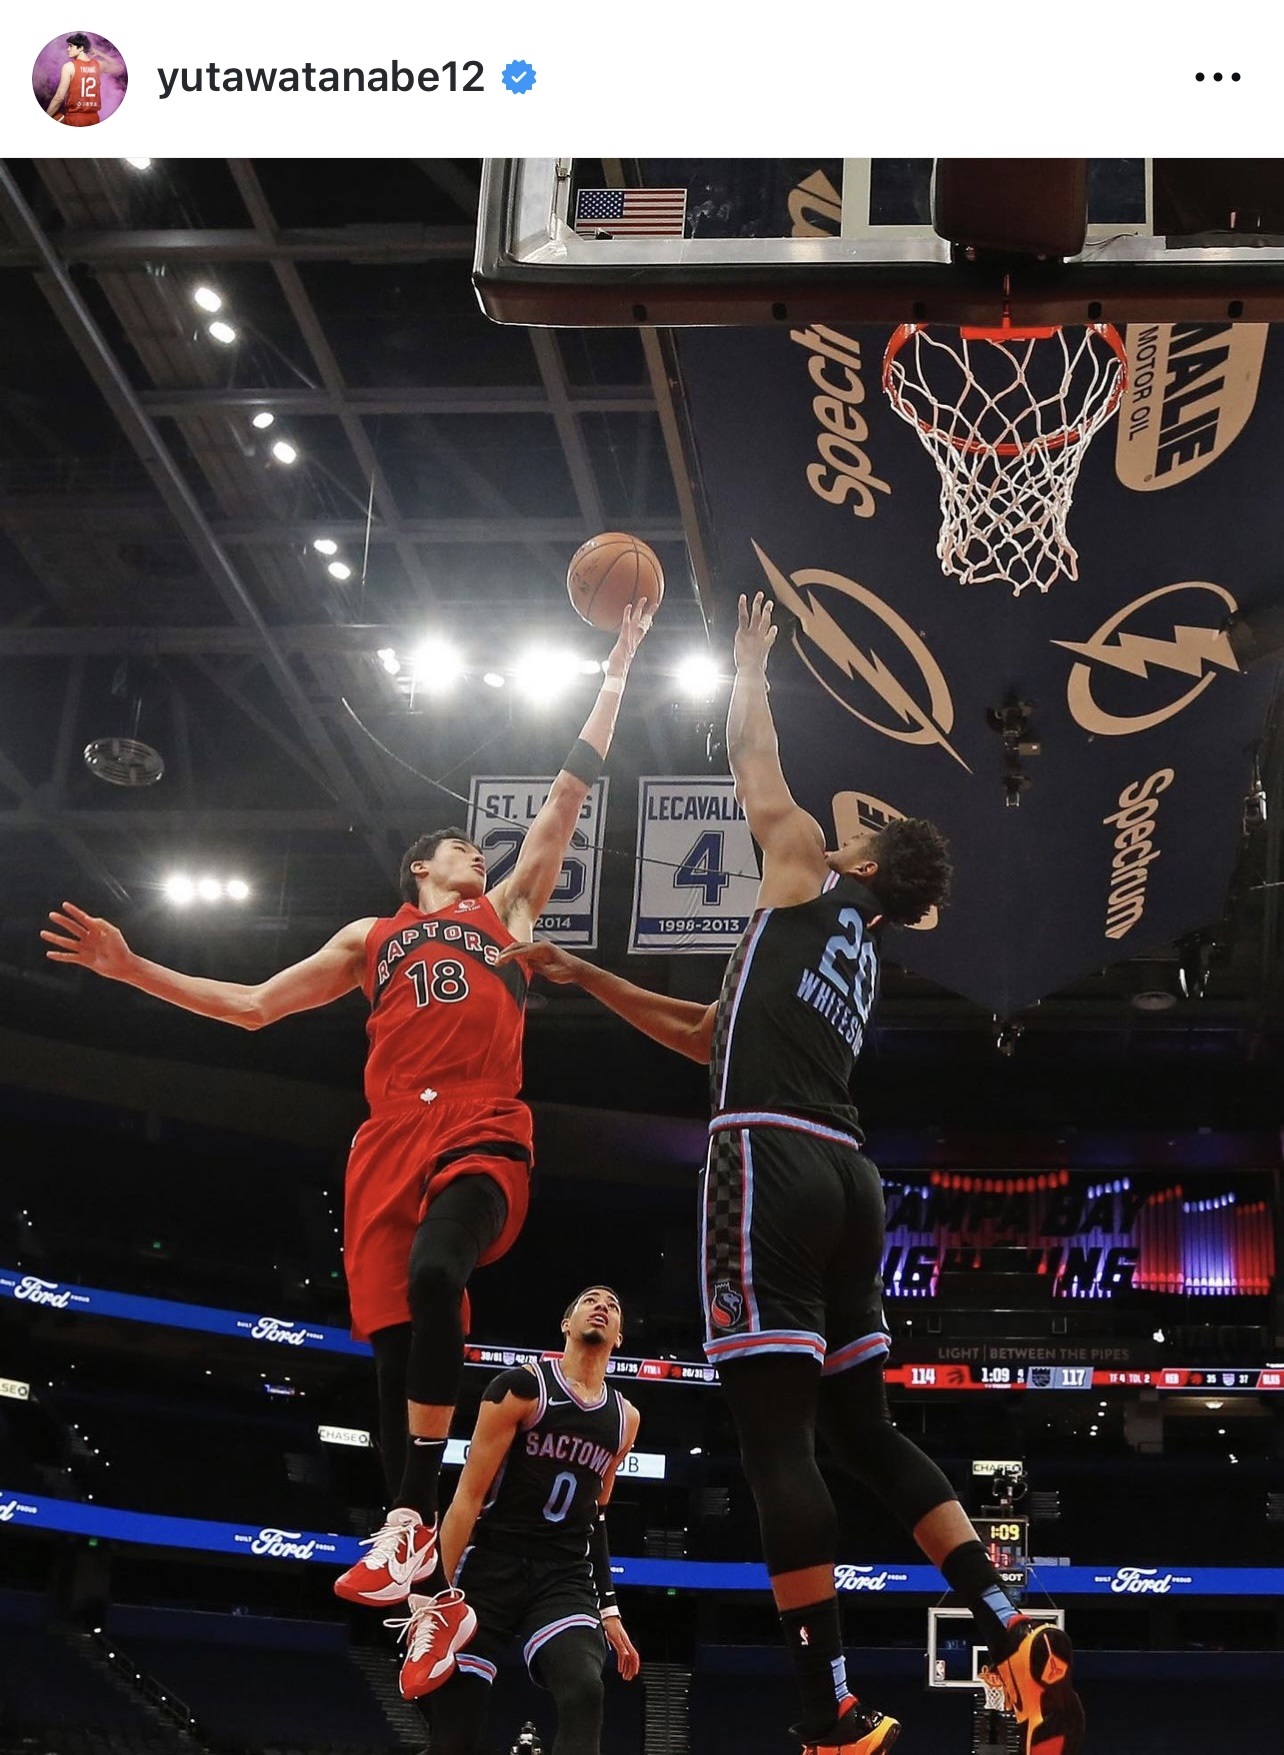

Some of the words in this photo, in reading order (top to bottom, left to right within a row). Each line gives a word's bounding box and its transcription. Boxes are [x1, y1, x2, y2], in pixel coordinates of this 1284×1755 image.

[81, 77, 96, 98] 12
[1133, 325, 1159, 403] MOTOR
[1128, 406, 1151, 442] OIL
[485, 794, 518, 819] ST.
[1103, 768, 1175, 939] Spectrum
[673, 830, 730, 906] 4
[658, 919, 740, 932] 1998-2013
[378, 921, 500, 985] RAPTORS
[404, 959, 469, 1008] 18
[14, 1276, 72, 1308] Ford
[251, 1317, 307, 1346] Ford
[938, 1347, 980, 1360] LIGHT
[990, 1348, 1056, 1360] BETWEEN
[1060, 1348, 1087, 1360] THE
[1091, 1348, 1130, 1361] PIPES
[911, 1367, 936, 1385] 114
[981, 1367, 1010, 1383] 1:09
[1061, 1369, 1086, 1386] 117
[543, 1471, 578, 1523] 0
[251, 1528, 316, 1560] Ford
[990, 1524, 1020, 1541] 1:09
[834, 1564, 888, 1591] Ford
[1000, 1573, 1024, 1582] SOT
[1110, 1566, 1173, 1594] Ford
